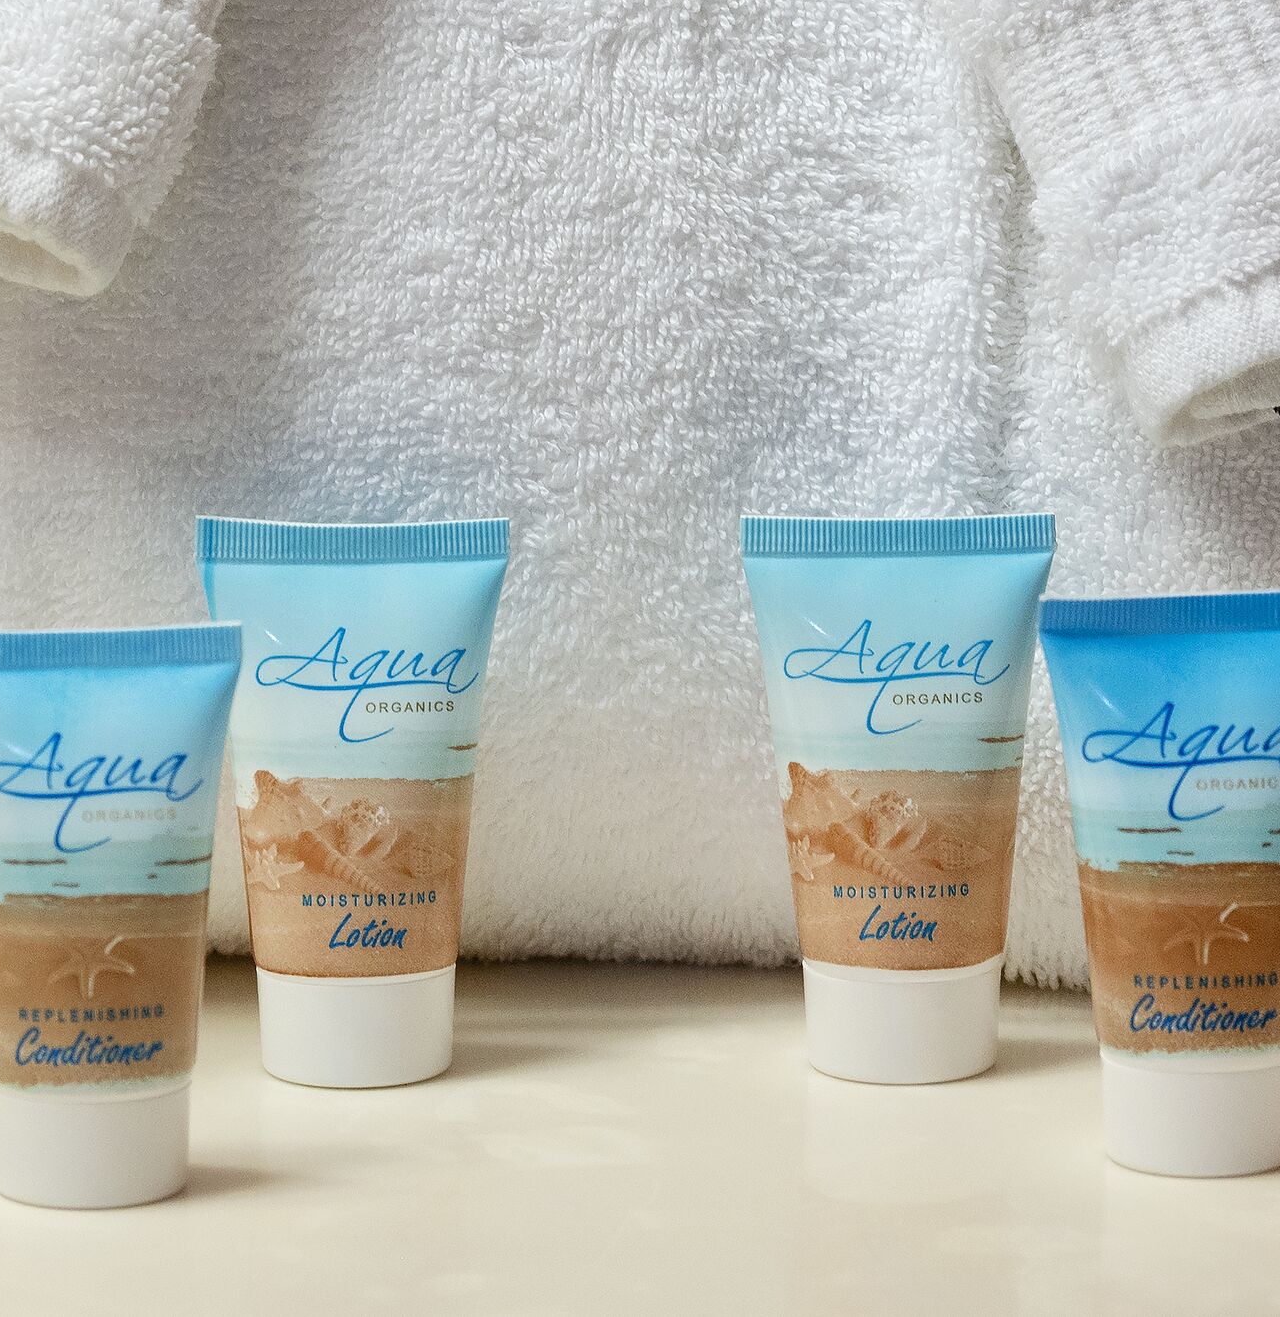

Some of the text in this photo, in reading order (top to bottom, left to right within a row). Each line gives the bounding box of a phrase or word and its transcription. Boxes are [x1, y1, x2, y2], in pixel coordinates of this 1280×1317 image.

[255, 626, 479, 743] Aqua
[783, 619, 1011, 734] Aqua
[365, 699, 456, 715] ORGANICS
[891, 691, 984, 706] ORGANICS
[81, 807, 178, 824] ORGANICS
[301, 890, 438, 908] MOISTURIZING
[833, 882, 970, 900] MOISTURIZING
[328, 913, 407, 950] Lotion
[858, 904, 937, 943] Lotion
[1133, 972, 1279, 990] REPLENISHING
[18, 1004, 165, 1022] REPLENISHING
[1129, 992, 1277, 1034] Conditioner
[14, 1026, 163, 1068] Conditioner
